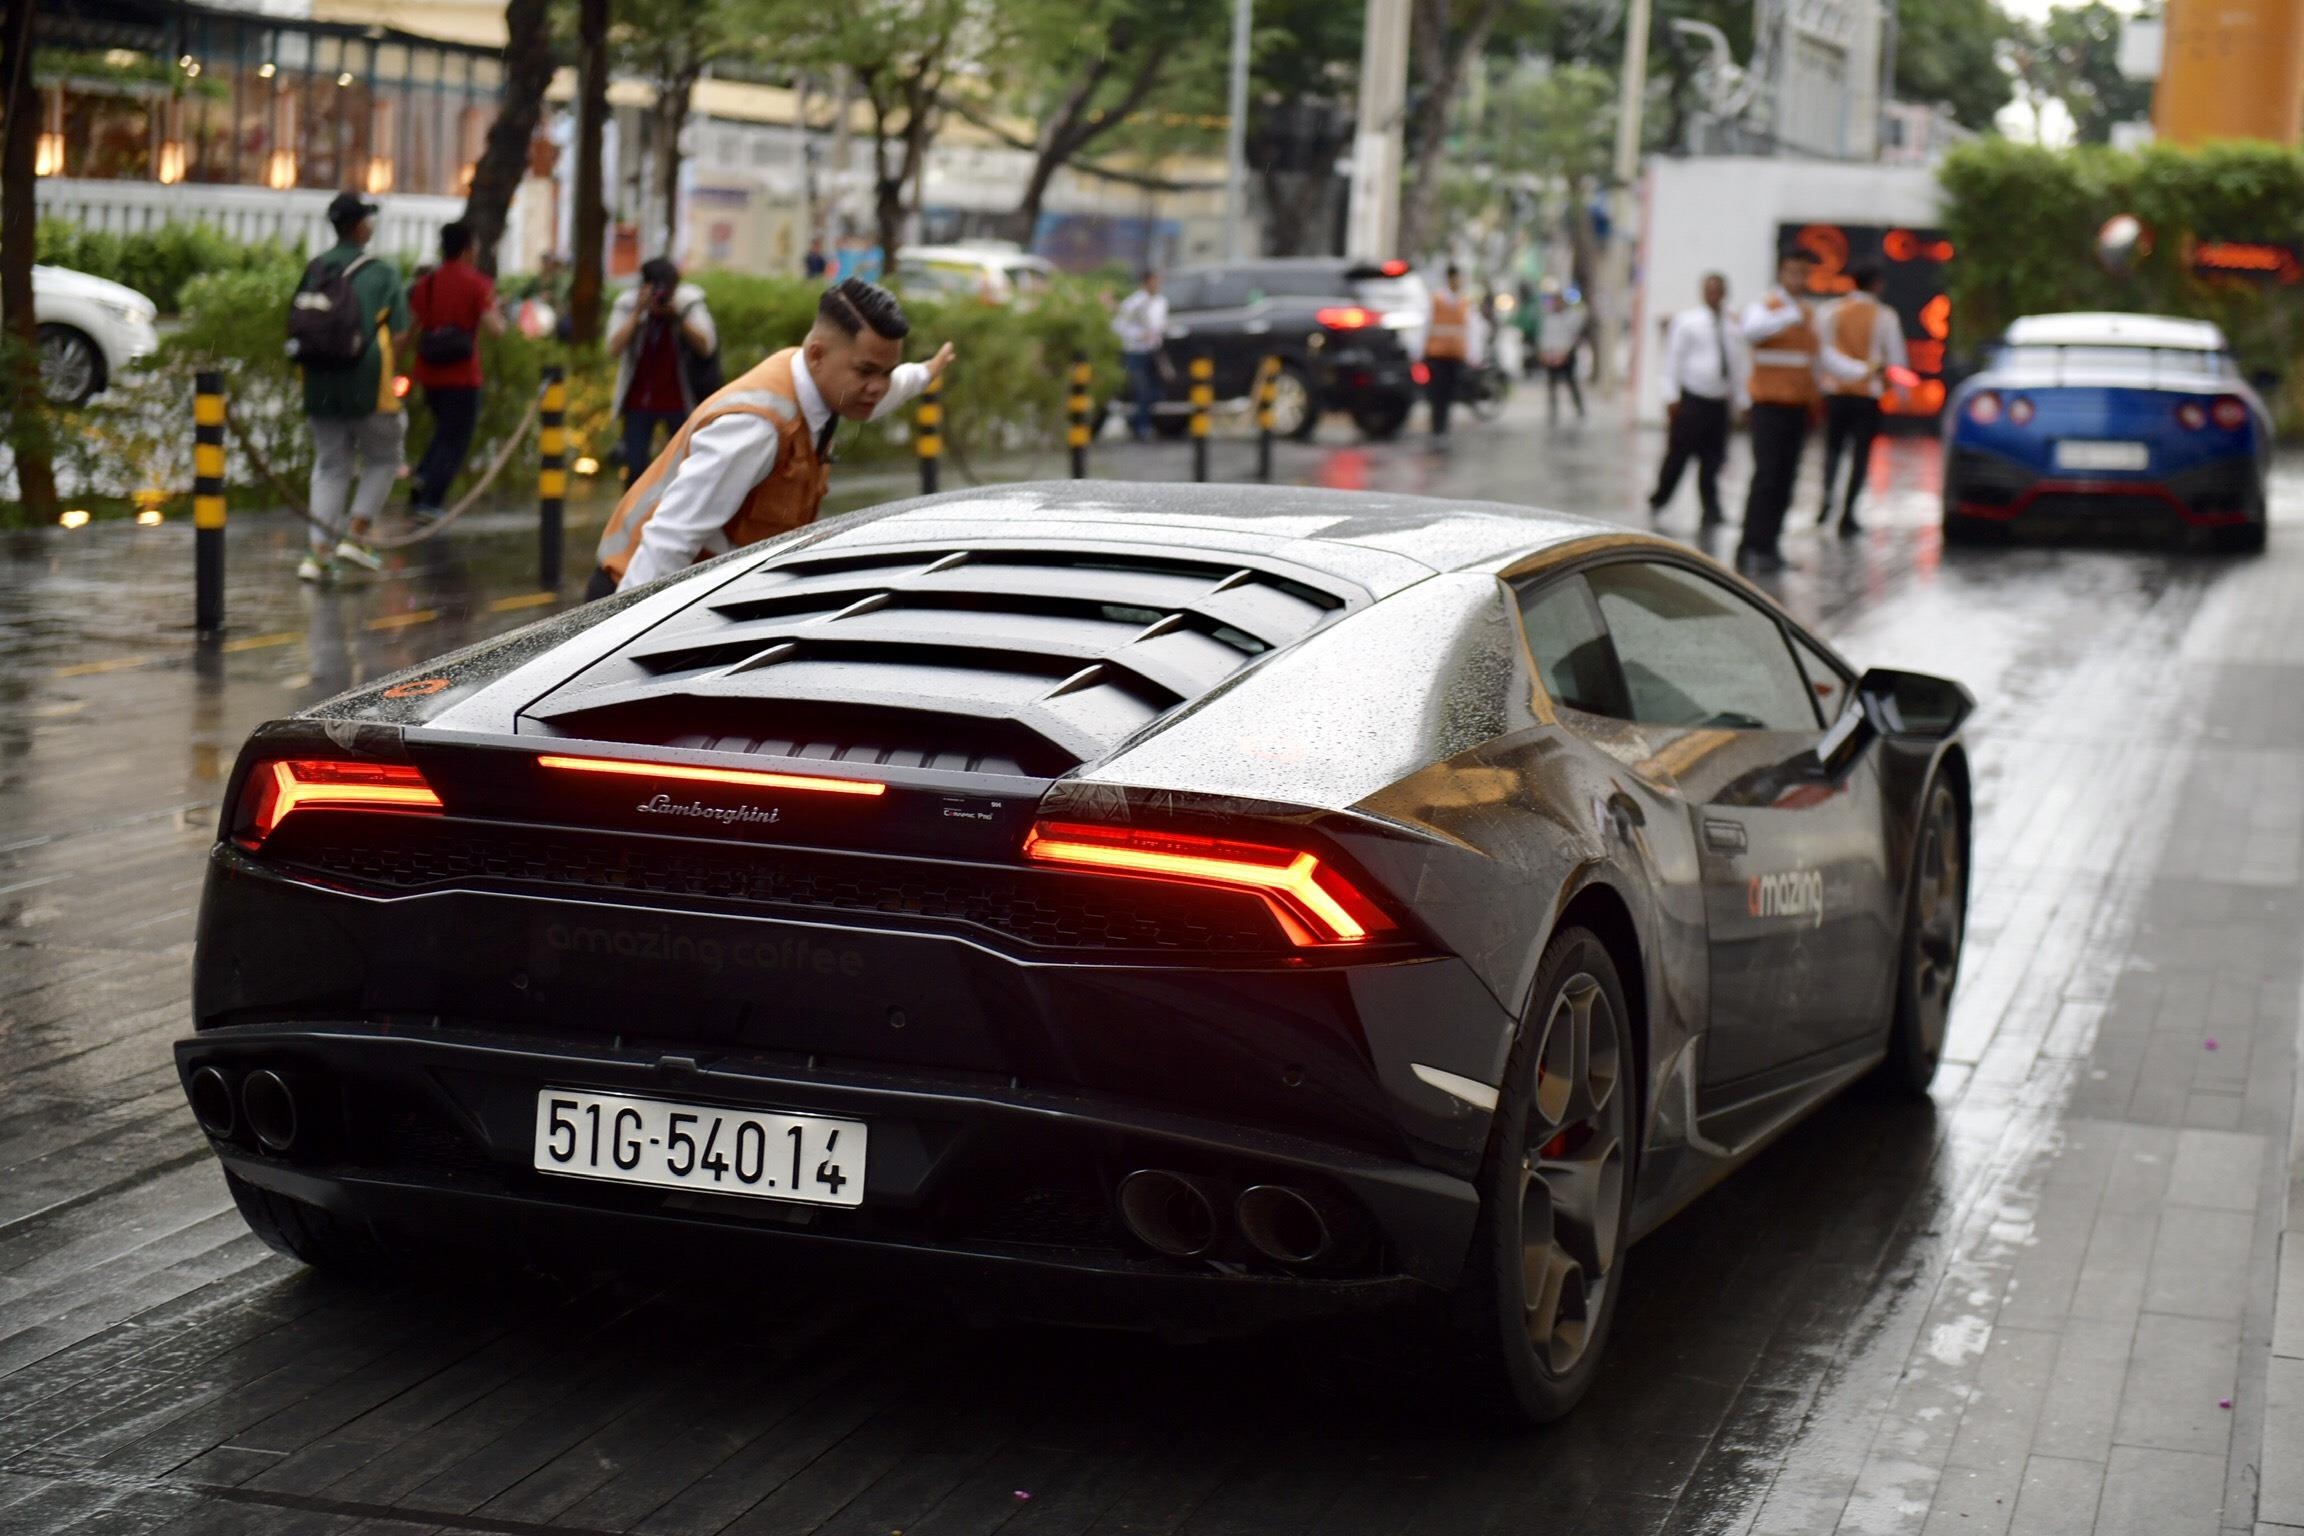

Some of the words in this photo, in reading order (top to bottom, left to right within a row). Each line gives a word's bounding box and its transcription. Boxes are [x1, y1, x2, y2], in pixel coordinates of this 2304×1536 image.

[636, 794, 780, 825] Lamborghini
[1748, 870, 1823, 929] amazing
[545, 921, 724, 969] amazing
[735, 937, 865, 977] coffee
[549, 1098, 847, 1195] 51G-540.14
